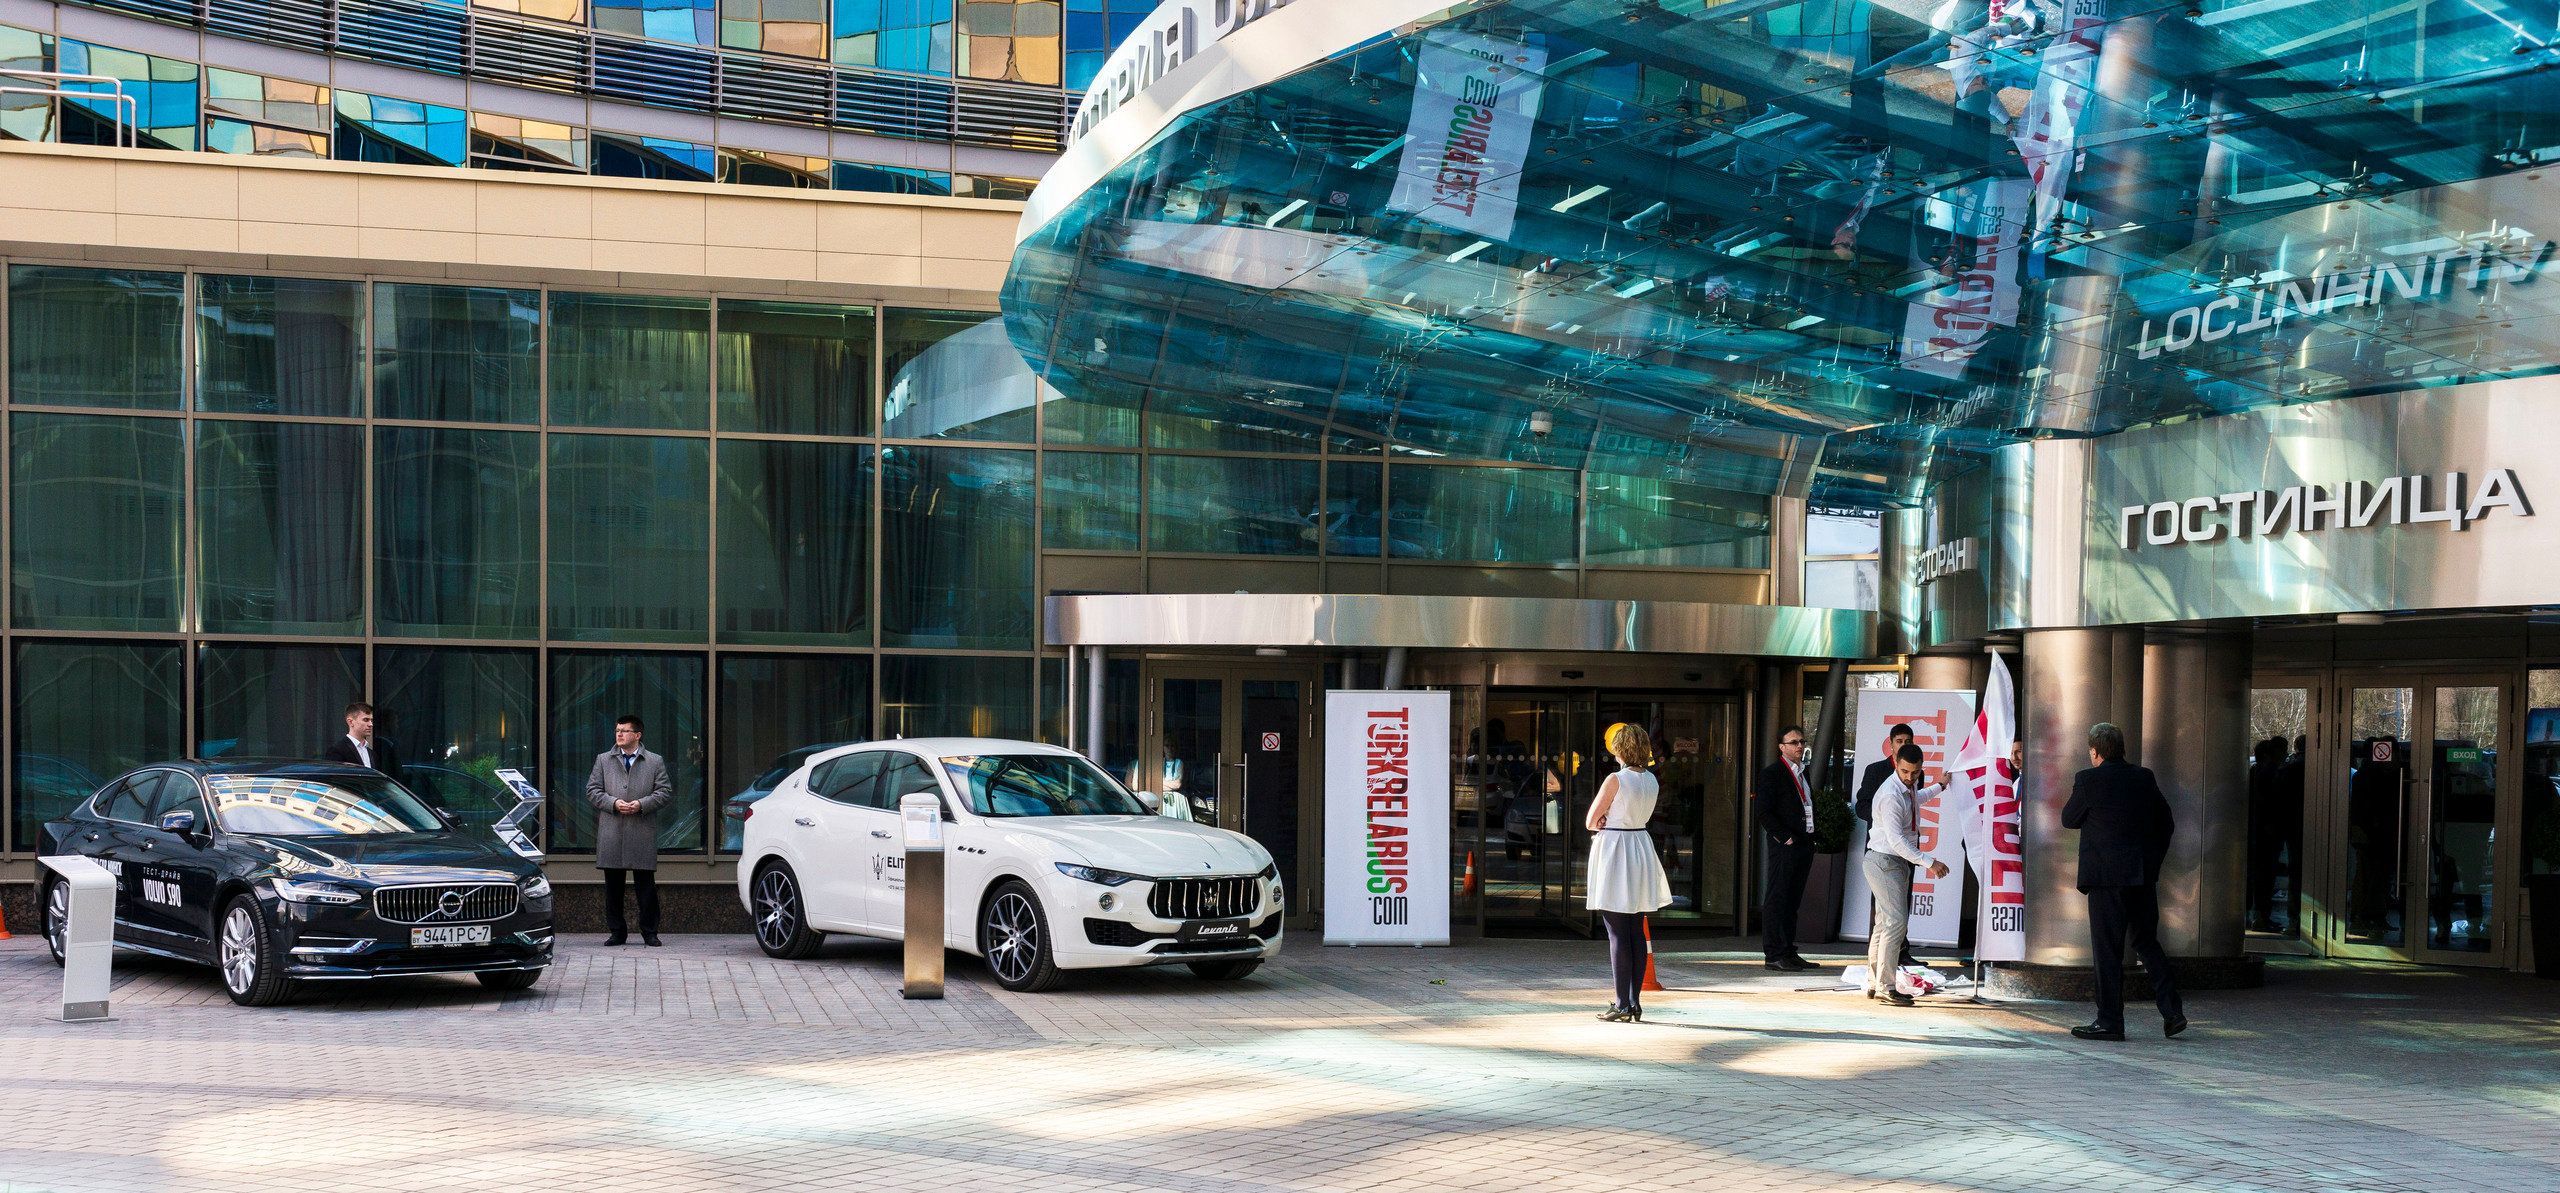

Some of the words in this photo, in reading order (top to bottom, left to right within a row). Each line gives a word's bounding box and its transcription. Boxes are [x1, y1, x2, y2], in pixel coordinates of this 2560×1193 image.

[2120, 468, 2533, 549] ГОСТИНИЦА
[2453, 751, 2477, 760] ВХОД
[143, 867, 180, 880] ТЕСТ-ДРАЙВ
[143, 879, 165, 904] VOLVO
[1197, 924, 1239, 935] Levante
